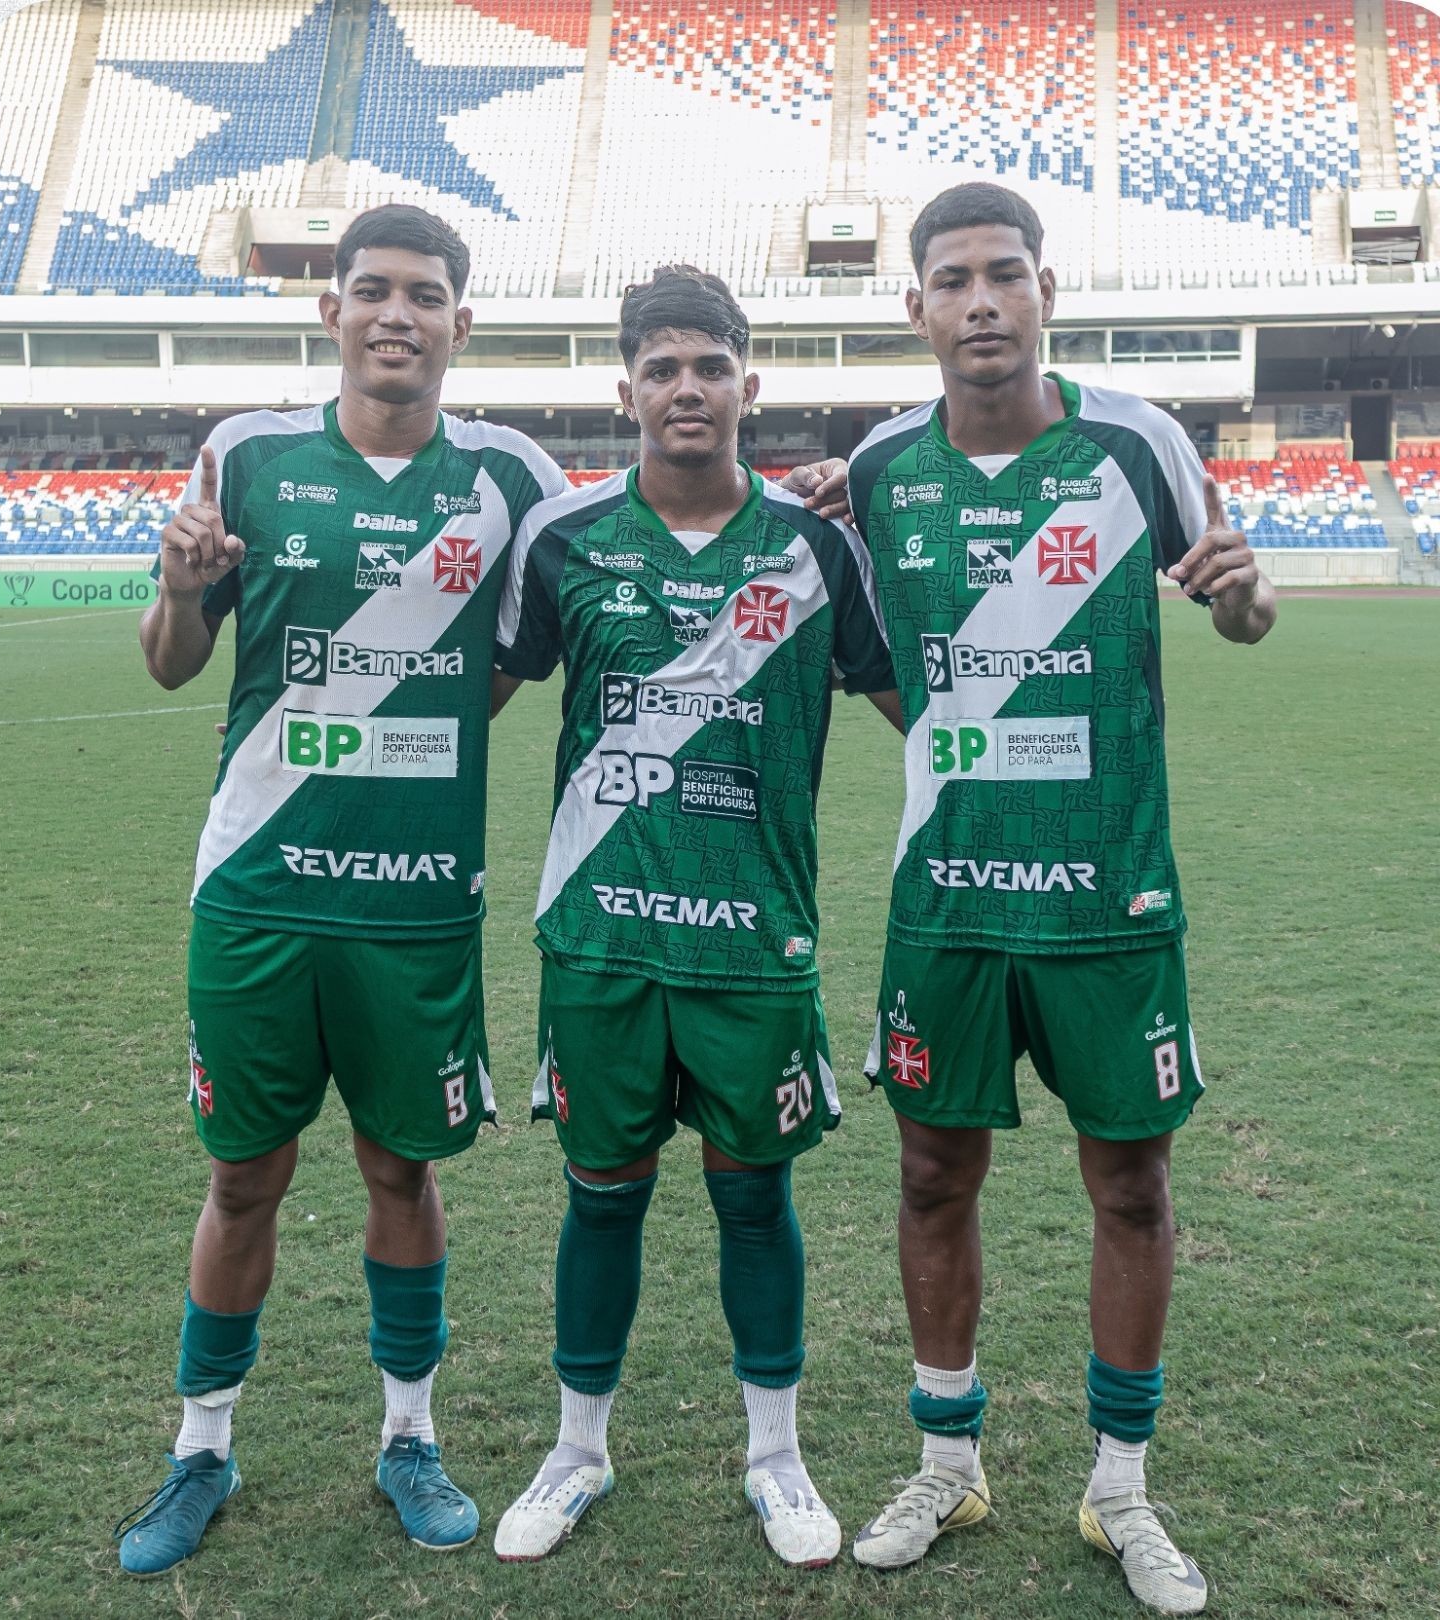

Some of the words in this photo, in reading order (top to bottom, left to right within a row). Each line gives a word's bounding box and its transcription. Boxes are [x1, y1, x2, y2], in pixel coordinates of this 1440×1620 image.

[297, 484, 338, 495] AUGUSTO
[907, 483, 944, 494] AUGUSTO
[353, 512, 418, 532] Dallas
[959, 507, 1023, 526] Dallas
[274, 554, 320, 571] Golkiper
[898, 556, 936, 571] Golkiper
[52, 579, 112, 605] Copa
[120, 579, 149, 600] do
[662, 580, 726, 600] Dallas
[602, 600, 650, 616] Golkiper
[331, 642, 464, 681] Banpará
[954, 644, 1093, 681] Banpará
[640, 683, 764, 726] Banpará
[287, 720, 362, 769] BP
[383, 733, 450, 743] BENEFICENTE
[1008, 733, 1078, 744] BENEFICENTE
[382, 744, 451, 753] PORTUGUESA
[382, 754, 399, 763] DO
[932, 726, 988, 774] BP
[1008, 744, 1081, 754] PORTUGUESA
[1008, 756, 1025, 766] DO
[597, 751, 675, 807] BP
[682, 769, 737, 786] HOSPITAL
[682, 781, 755, 800] BENEFICENTE
[681, 793, 757, 813] PORTUGUESA
[279, 844, 457, 881] REVEMAR
[926, 858, 1097, 892] REVEMAR
[591, 884, 758, 931] REVEMAR
[1154, 1040, 1180, 1102] 8
[444, 1074, 469, 1128] 9
[776, 1070, 812, 1136] 20
